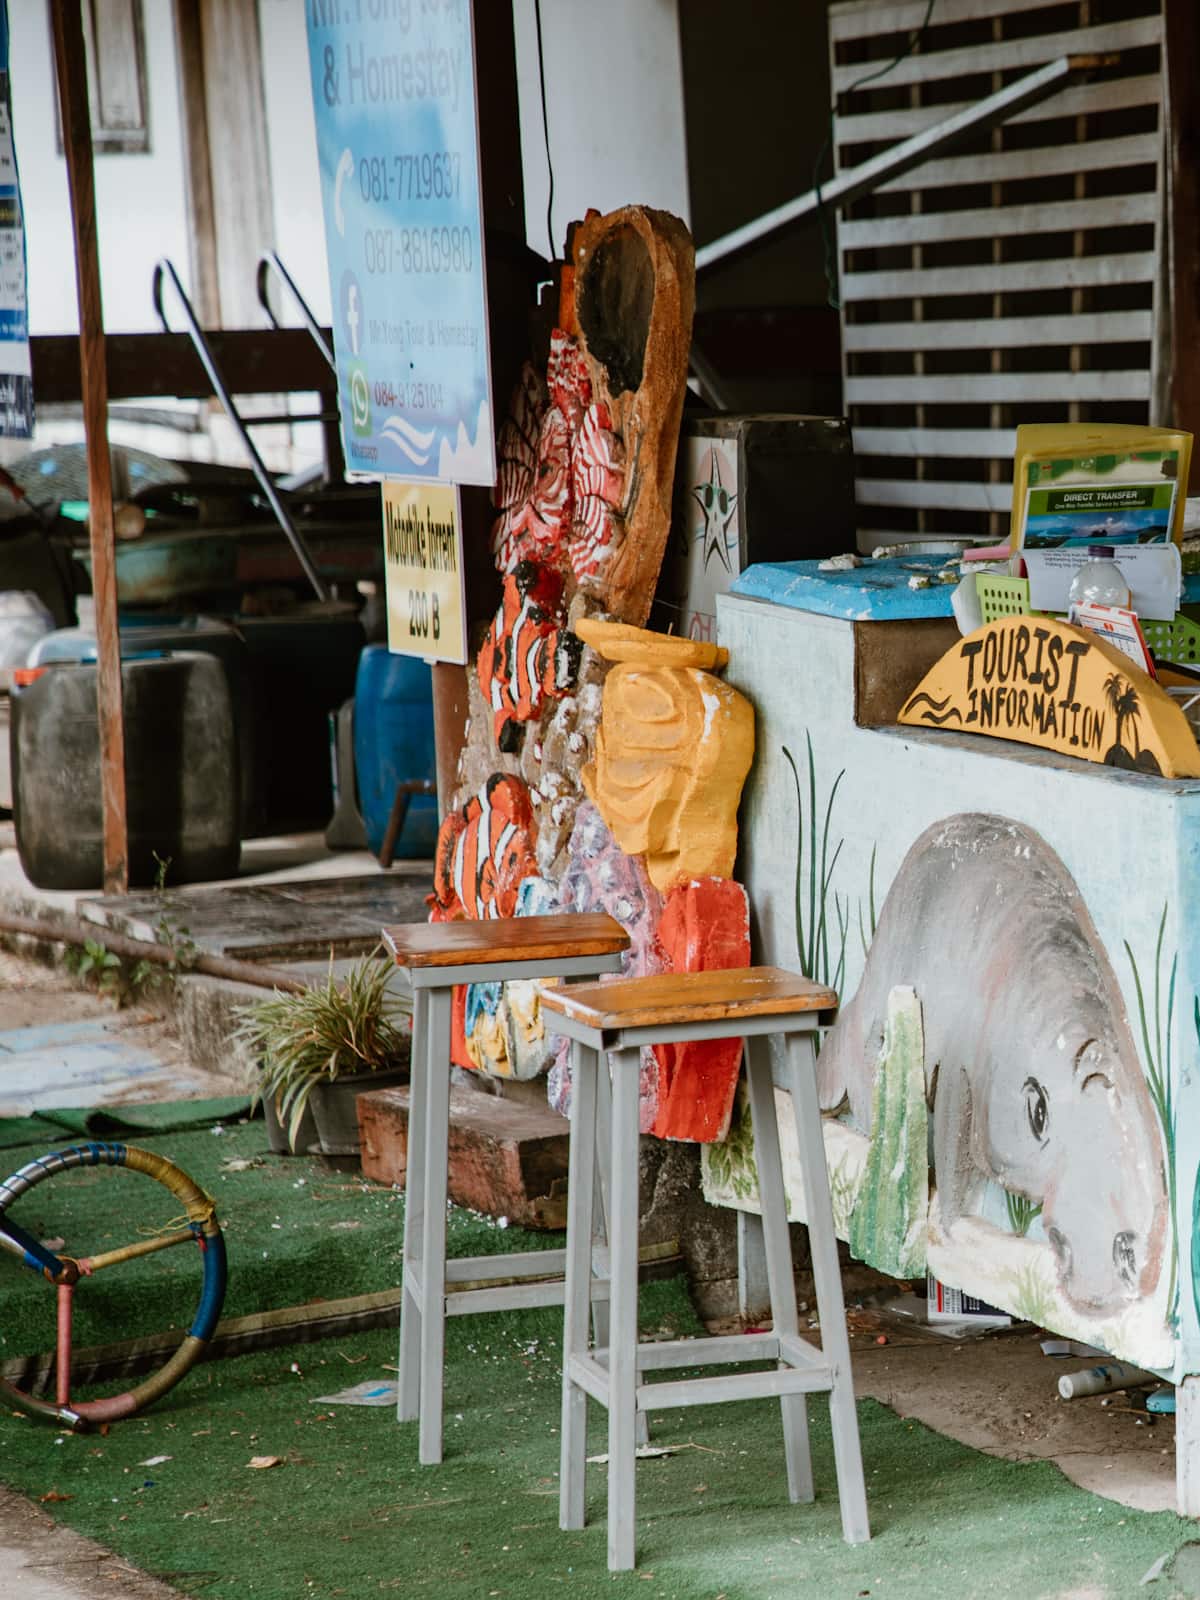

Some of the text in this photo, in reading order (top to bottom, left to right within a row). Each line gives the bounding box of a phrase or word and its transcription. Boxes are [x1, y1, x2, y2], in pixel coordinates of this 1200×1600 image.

[323, 37, 462, 112] & Homestay
[359, 152, 461, 204] 081-7719637
[1063, 490, 1138, 502] DIRECT TRANSFER
[385, 500, 427, 569] Motorbike
[408, 589, 429, 638] 200
[960, 624, 1091, 704] TOURIST
[965, 688, 1105, 751] INFORMATION
